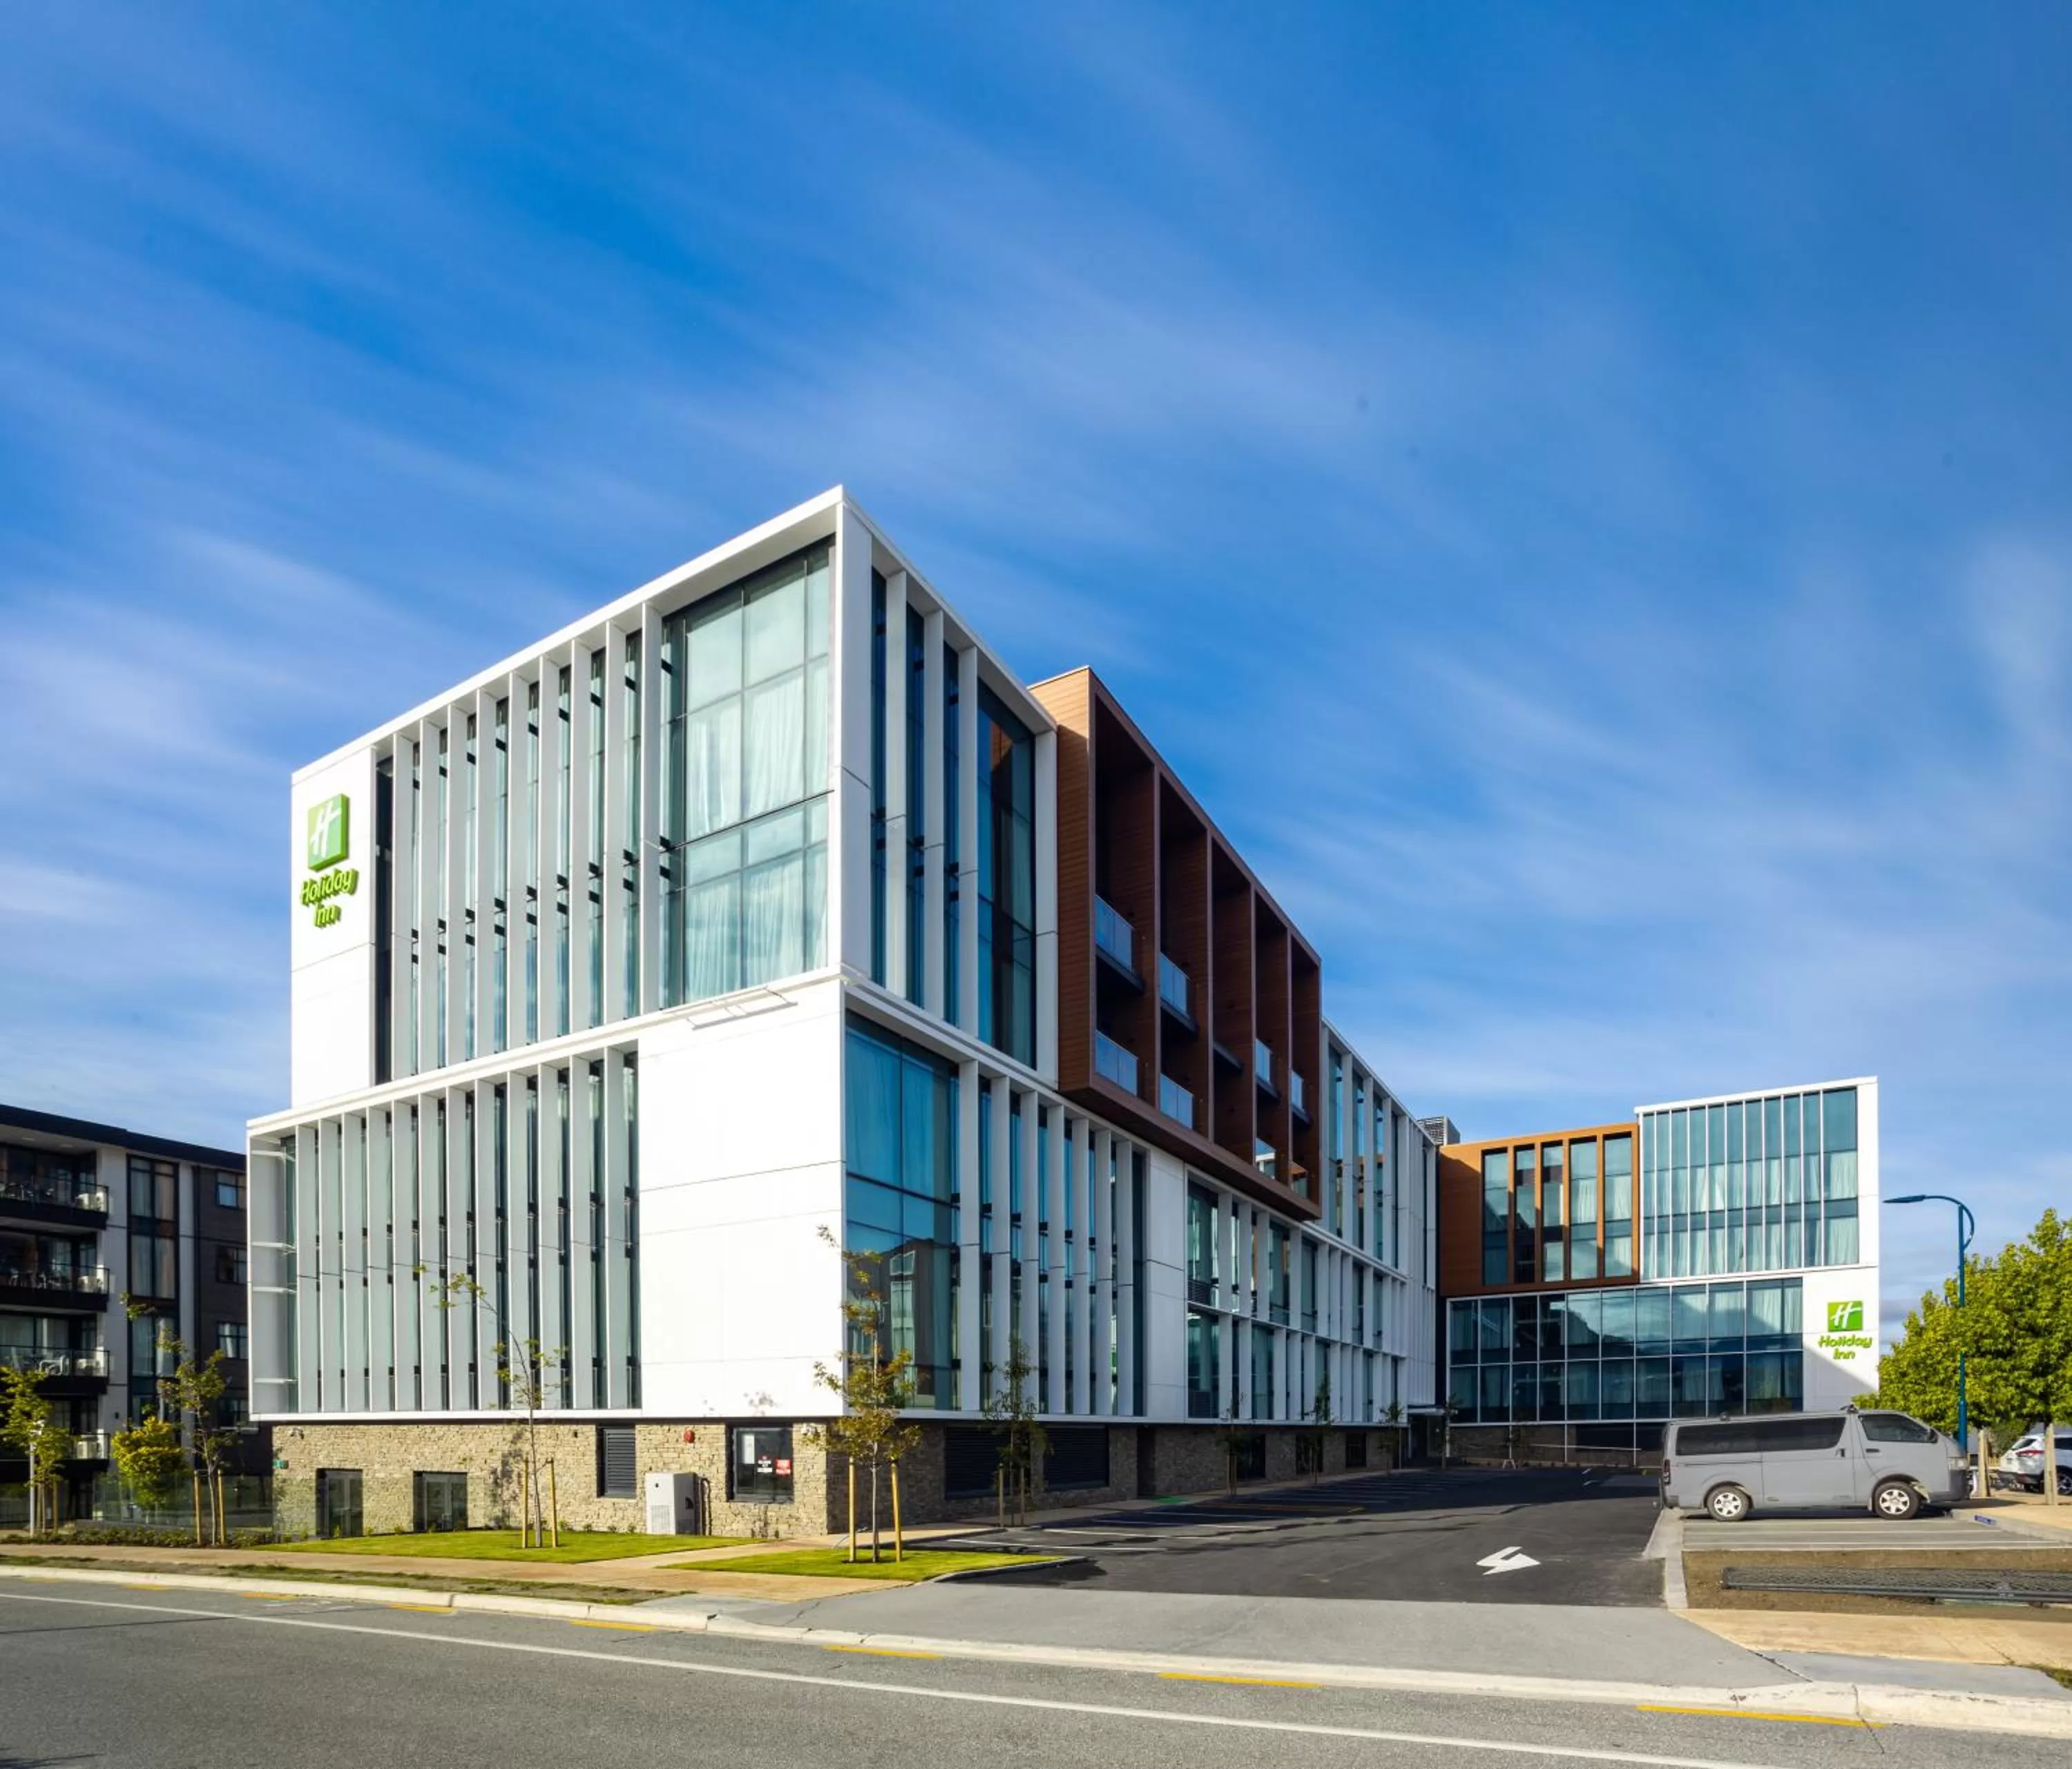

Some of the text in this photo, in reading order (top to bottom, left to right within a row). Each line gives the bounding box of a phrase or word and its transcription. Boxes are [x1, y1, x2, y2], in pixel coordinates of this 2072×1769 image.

[301, 868, 358, 906] Holiday
[315, 903, 342, 929] Inn
[1818, 1334, 1872, 1348] Holiday
[1833, 1348, 1855, 1360] Inn
